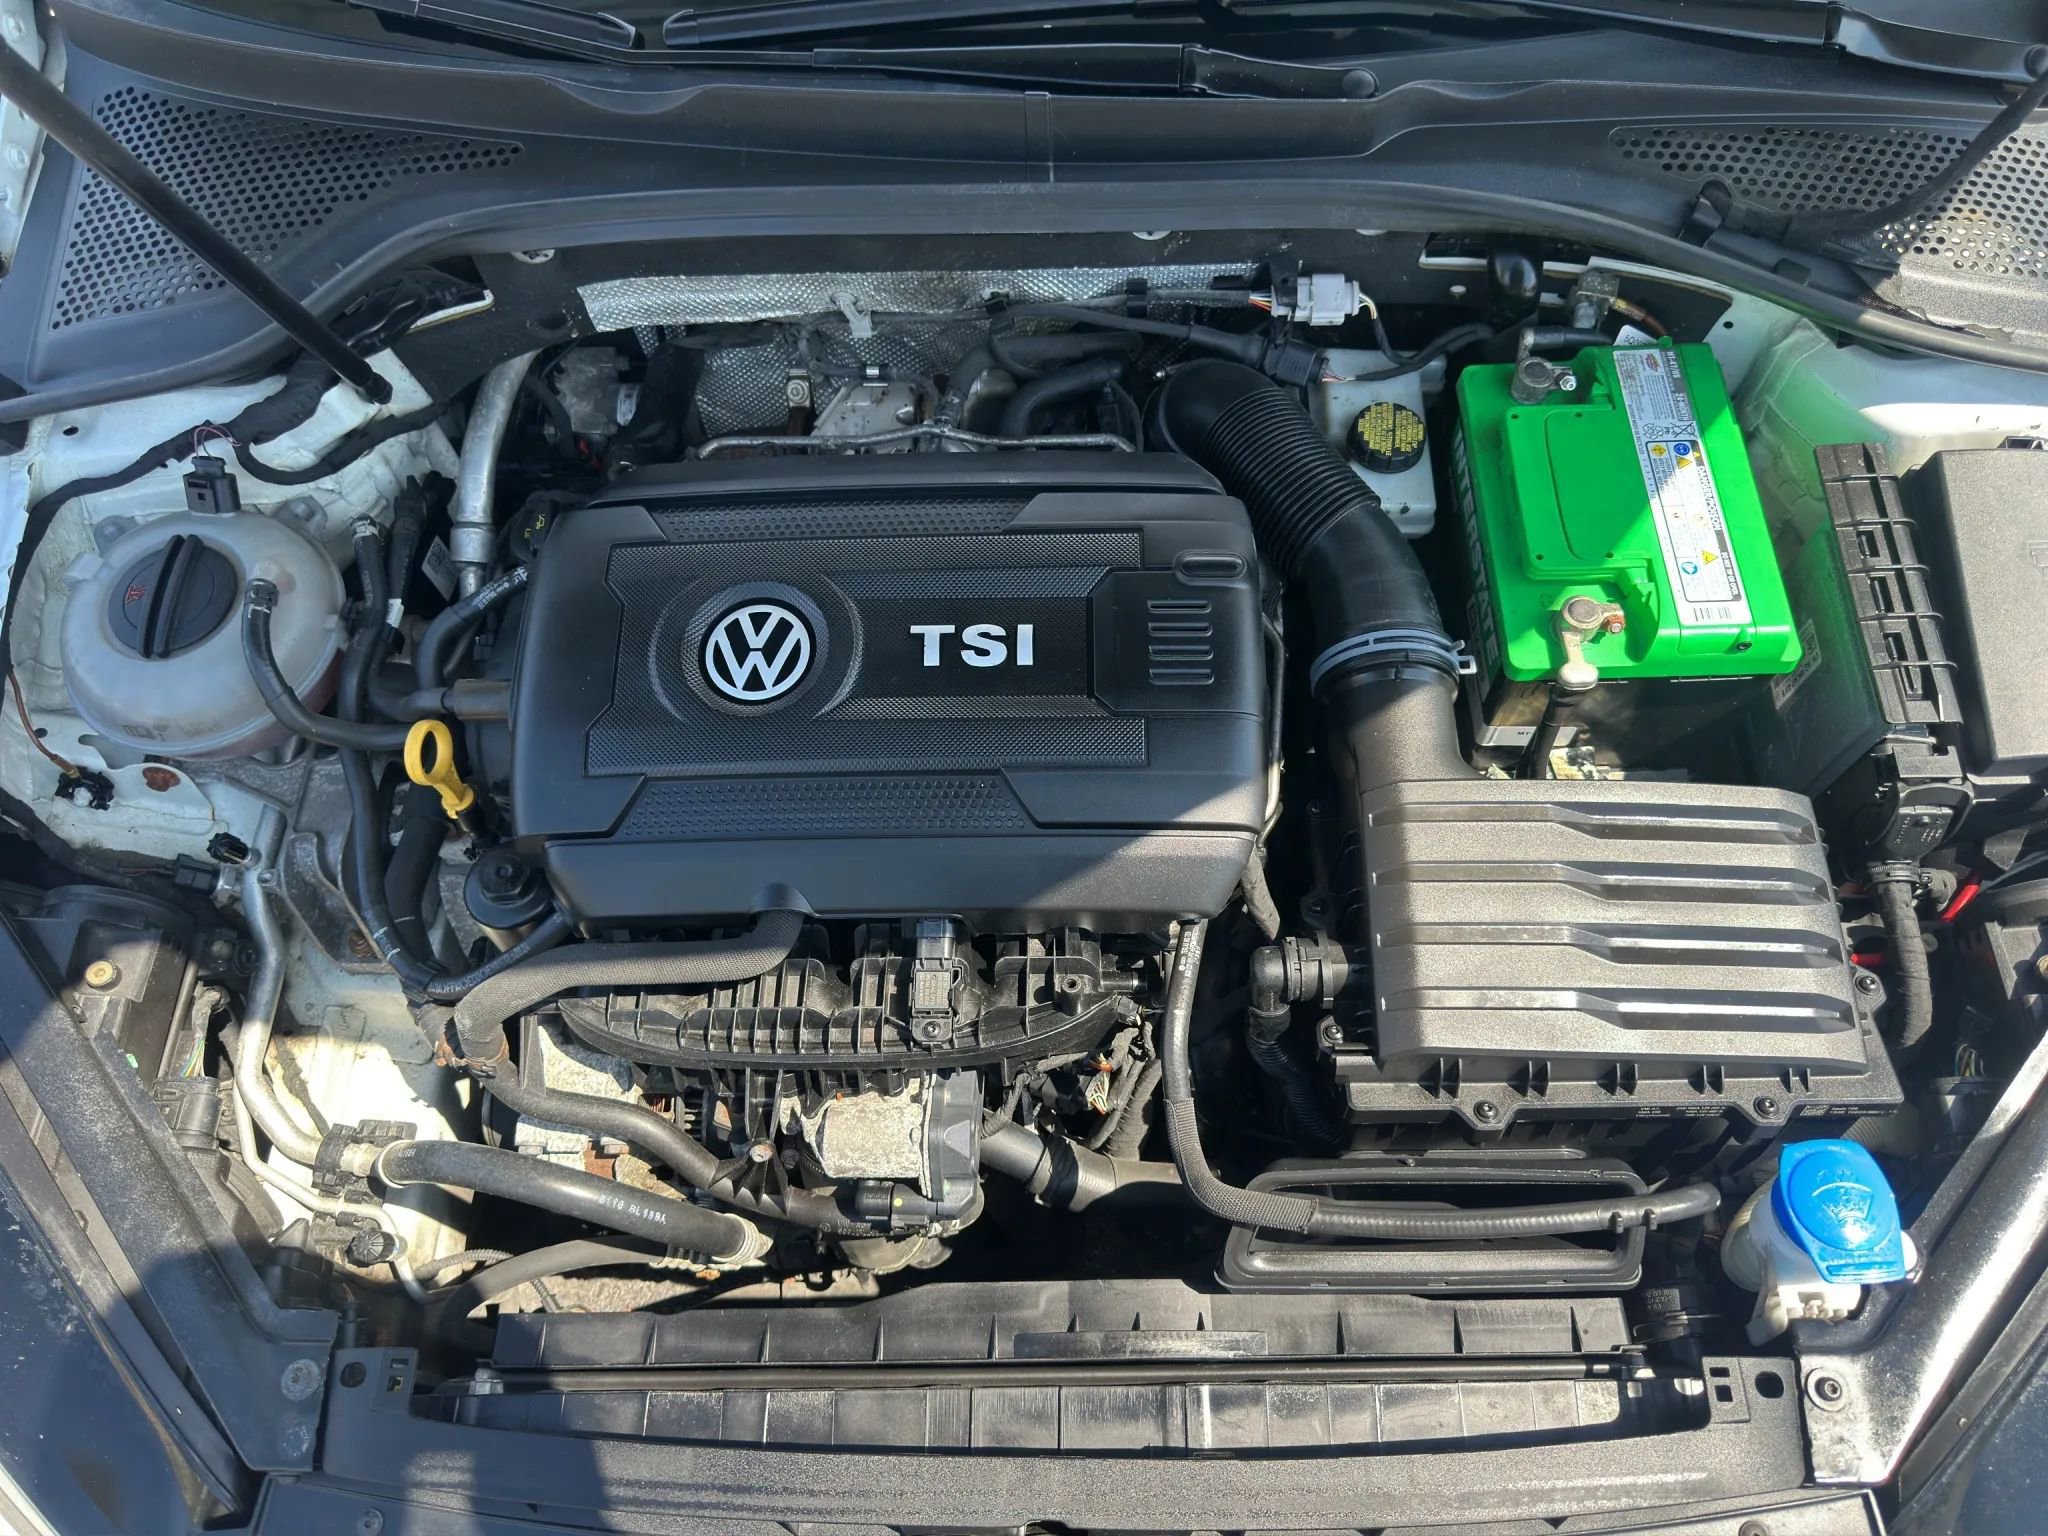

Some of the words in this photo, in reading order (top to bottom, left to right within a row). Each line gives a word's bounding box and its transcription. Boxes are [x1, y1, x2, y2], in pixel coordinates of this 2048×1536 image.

[1699, 466, 1722, 531] DANGER/POISON
[1453, 428, 1499, 666] INTERSTATE
[910, 624, 1034, 667] TSI
